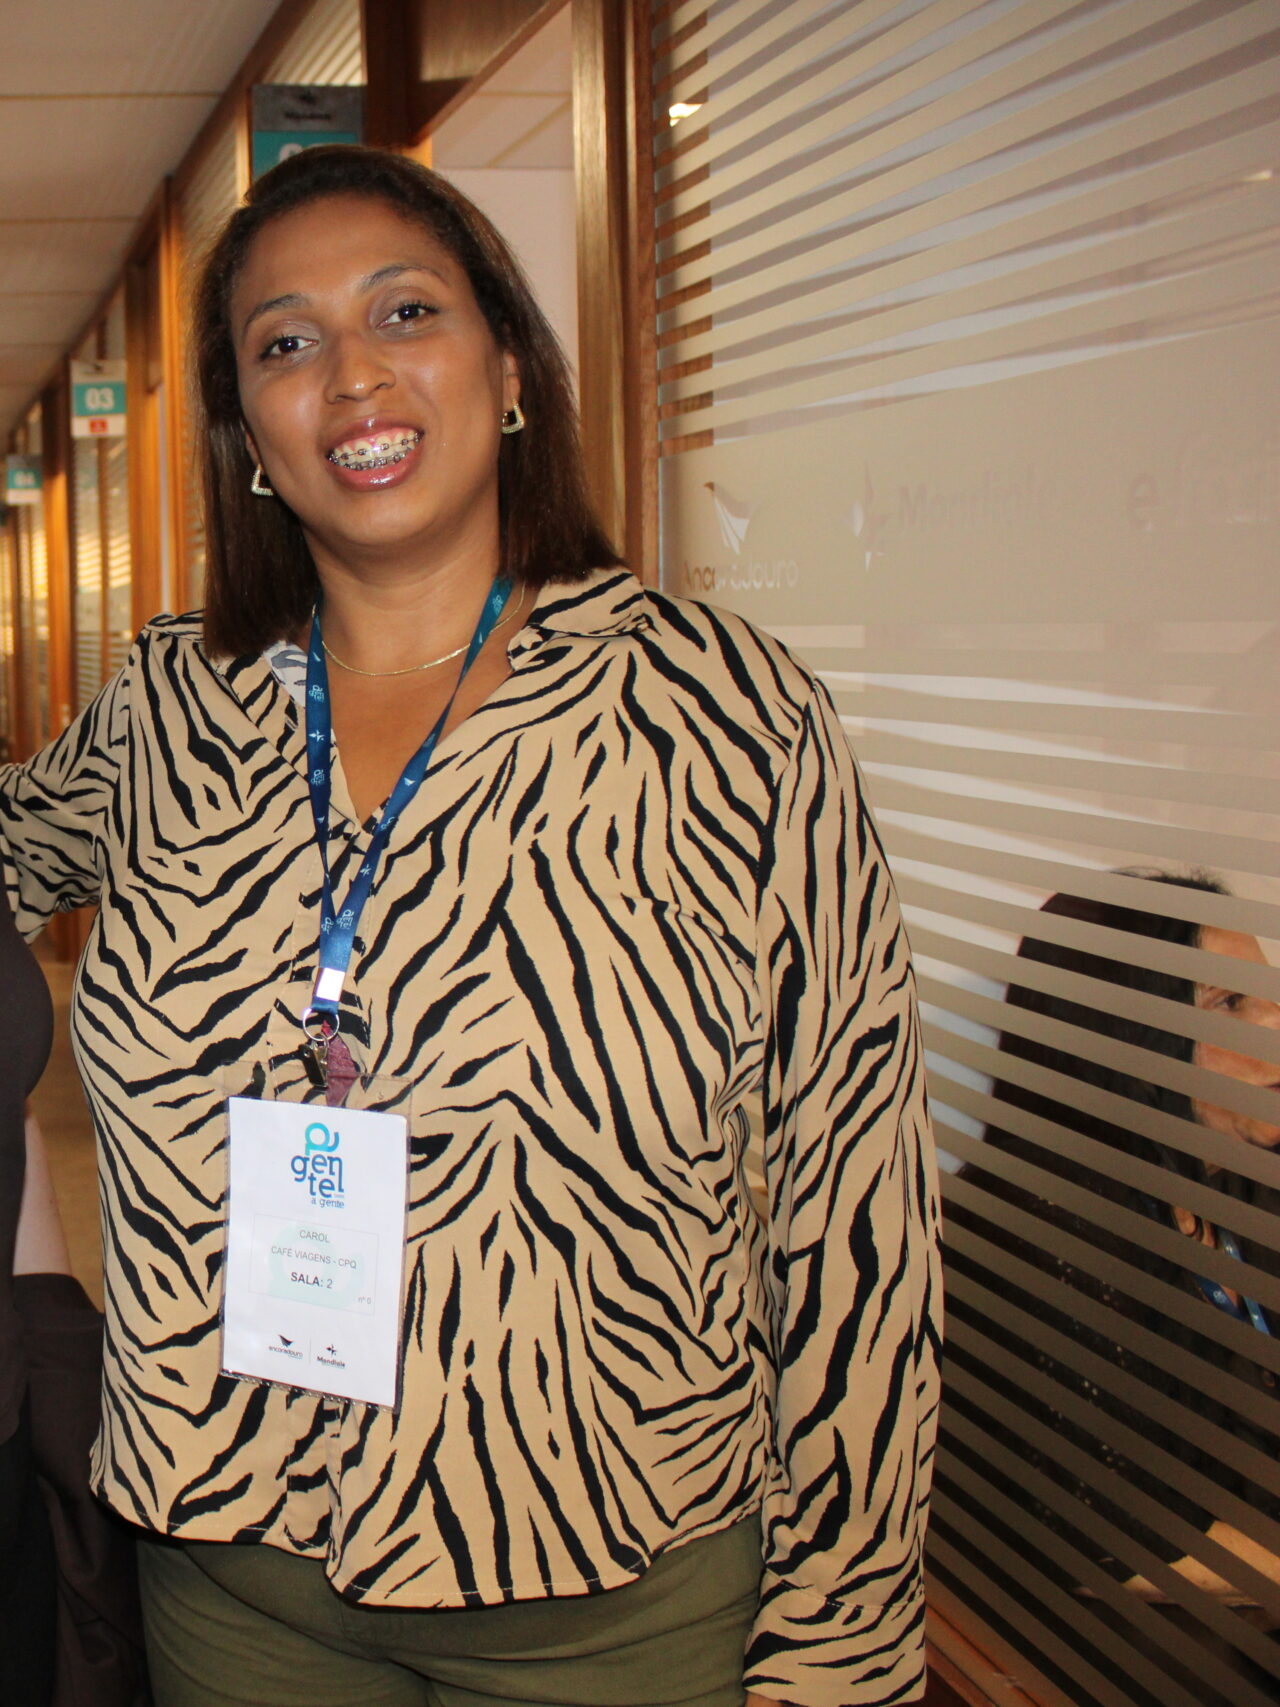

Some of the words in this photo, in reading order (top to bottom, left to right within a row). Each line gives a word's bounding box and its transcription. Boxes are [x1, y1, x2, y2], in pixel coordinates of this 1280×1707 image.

[85, 387, 114, 410] 03
[299, 1229, 331, 1244] CAROL
[294, 1249, 332, 1265] VIAGENS
[290, 1271, 324, 1288] SALA:
[326, 1278, 334, 1290] 2
